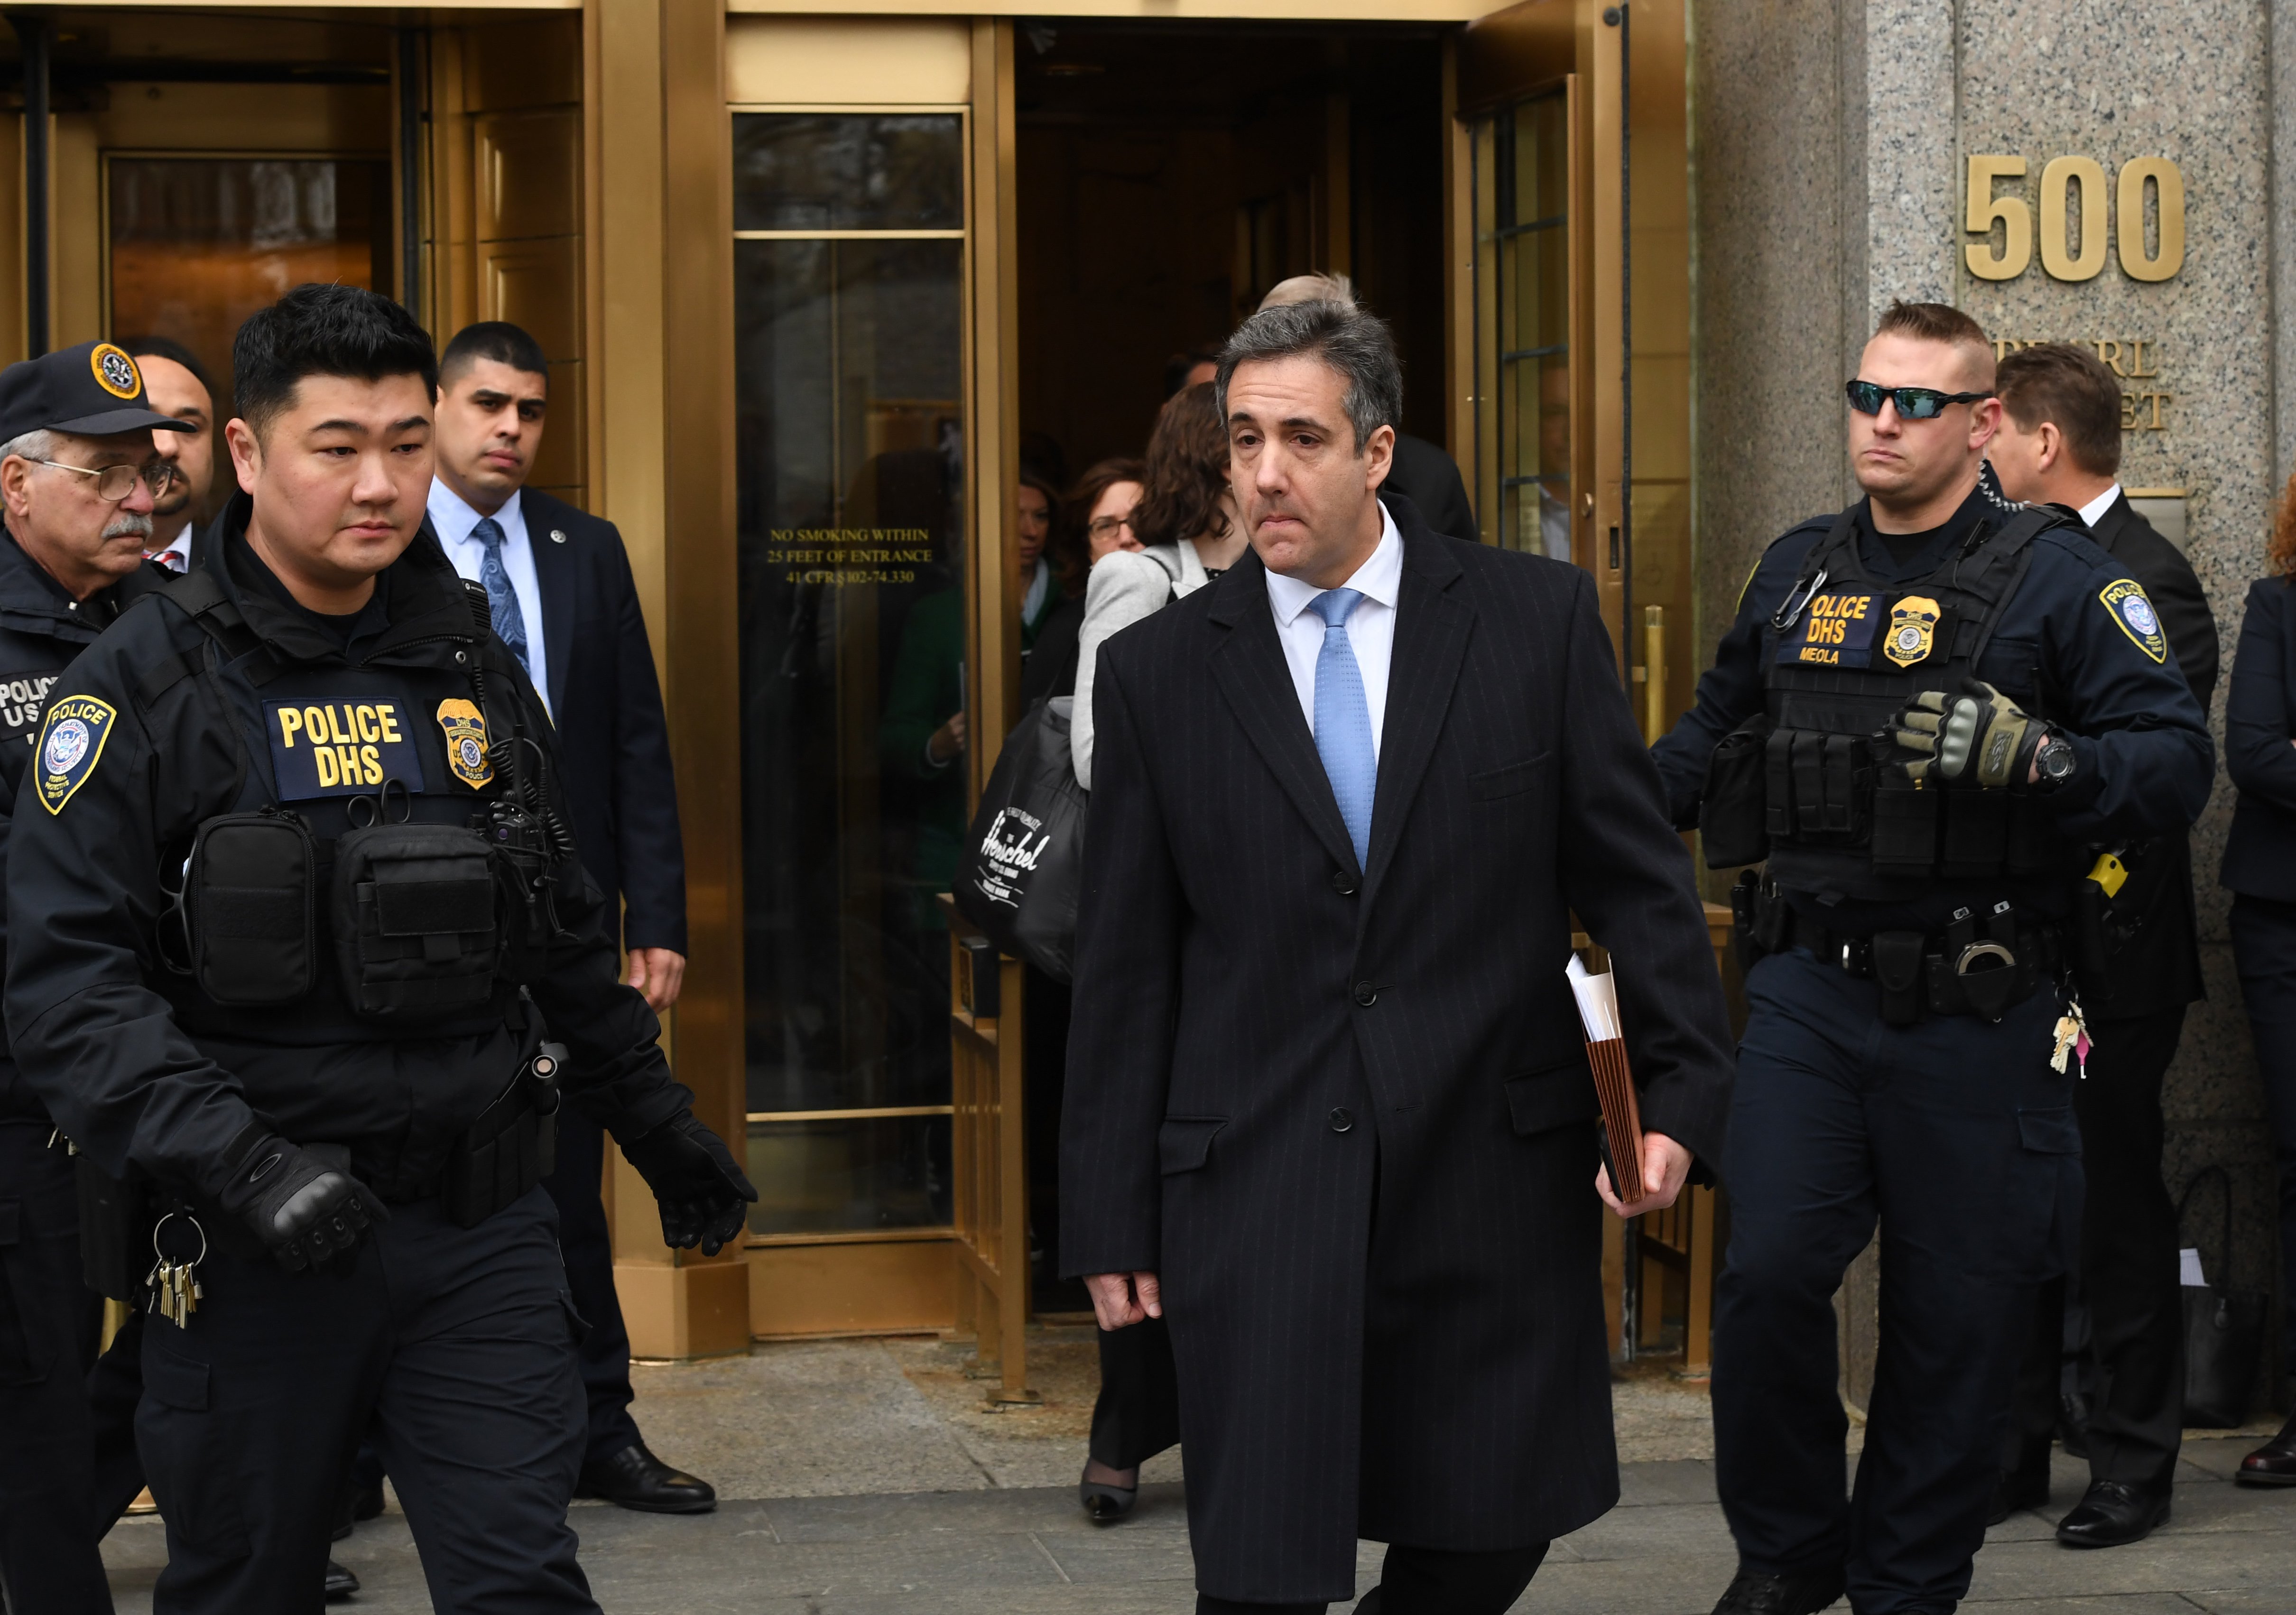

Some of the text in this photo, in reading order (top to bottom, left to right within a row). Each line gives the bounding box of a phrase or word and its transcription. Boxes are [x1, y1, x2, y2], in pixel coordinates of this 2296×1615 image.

[1964, 155, 2185, 282] 500
[770, 529, 929, 542] NO SMOKING WITHIN
[768, 549, 932, 563] 25 FEET OF ENTRANCE
[786, 571, 801, 584] 41
[1808, 595, 1871, 619] OLICE
[1806, 618, 1847, 644] DHS
[1799, 647, 1839, 665] MEOLA
[51, 704, 108, 725] POLICE
[455, 719, 472, 727] DHS
[278, 705, 402, 748] POLICE
[314, 745, 384, 788] DHS
[465, 771, 484, 780] POLICE
[981, 809, 1050, 871] Herschel
